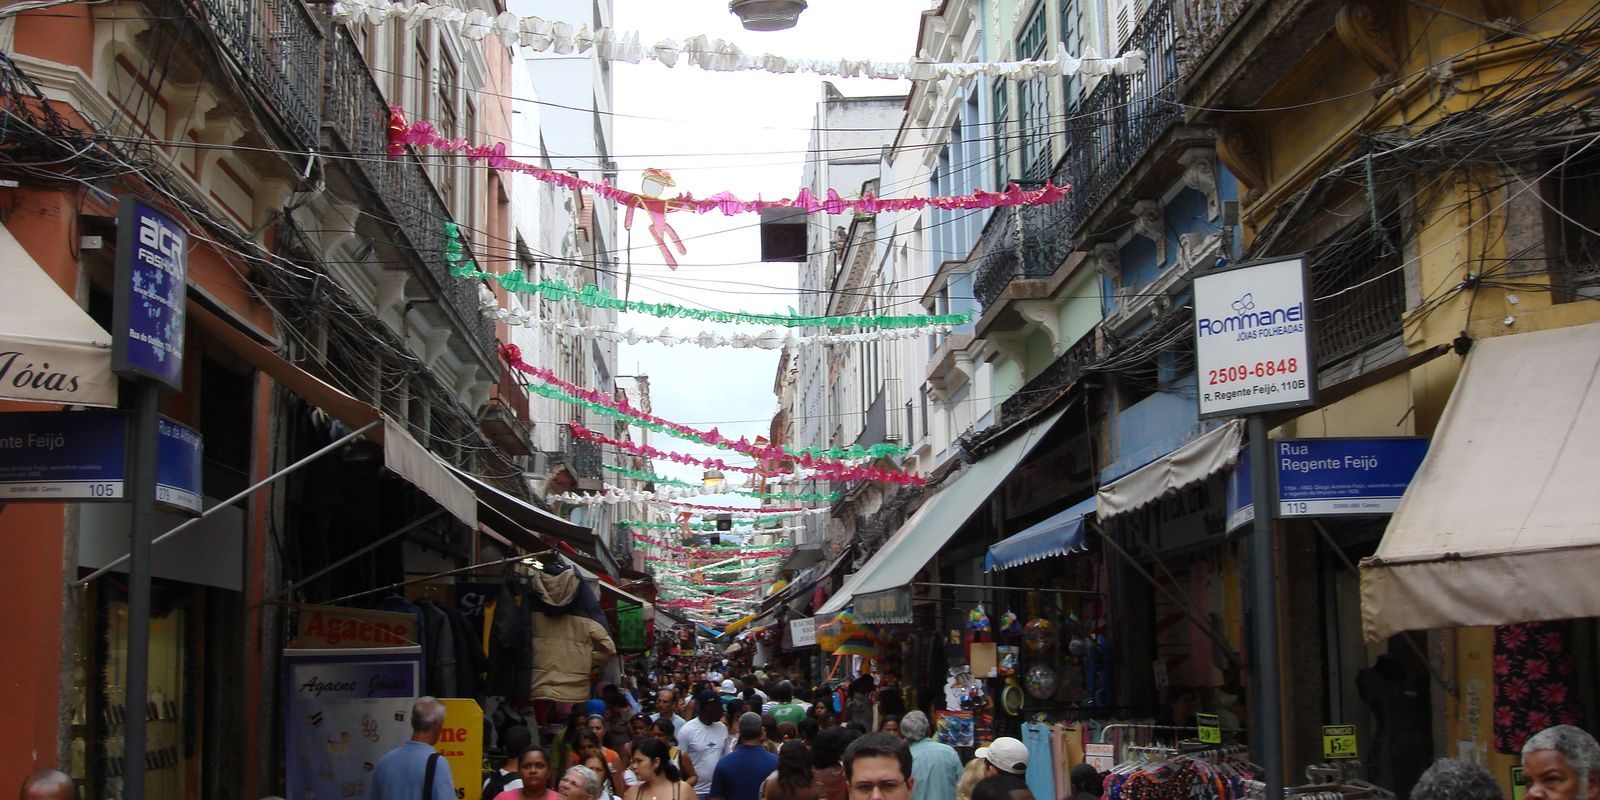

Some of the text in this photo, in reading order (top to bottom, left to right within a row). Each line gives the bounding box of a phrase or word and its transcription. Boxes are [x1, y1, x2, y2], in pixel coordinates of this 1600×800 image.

[1198, 302, 1304, 338] Rommanel
[1258, 323, 1304, 338] FOLHEADAS
[1208, 357, 1298, 386] 2509-6848
[1203, 393, 1213, 402] R.
[1214, 387, 1252, 401] Regente
[1281, 379, 1306, 391] 110B
[27, 432, 65, 450] Feijó
[1280, 442, 1309, 456] Rua
[1281, 454, 1379, 474] Regente Feijó
[88, 483, 114, 497] 105
[1287, 502, 1307, 514] 119
[304, 611, 408, 645] Agaene
[298, 676, 357, 697] Agaene
